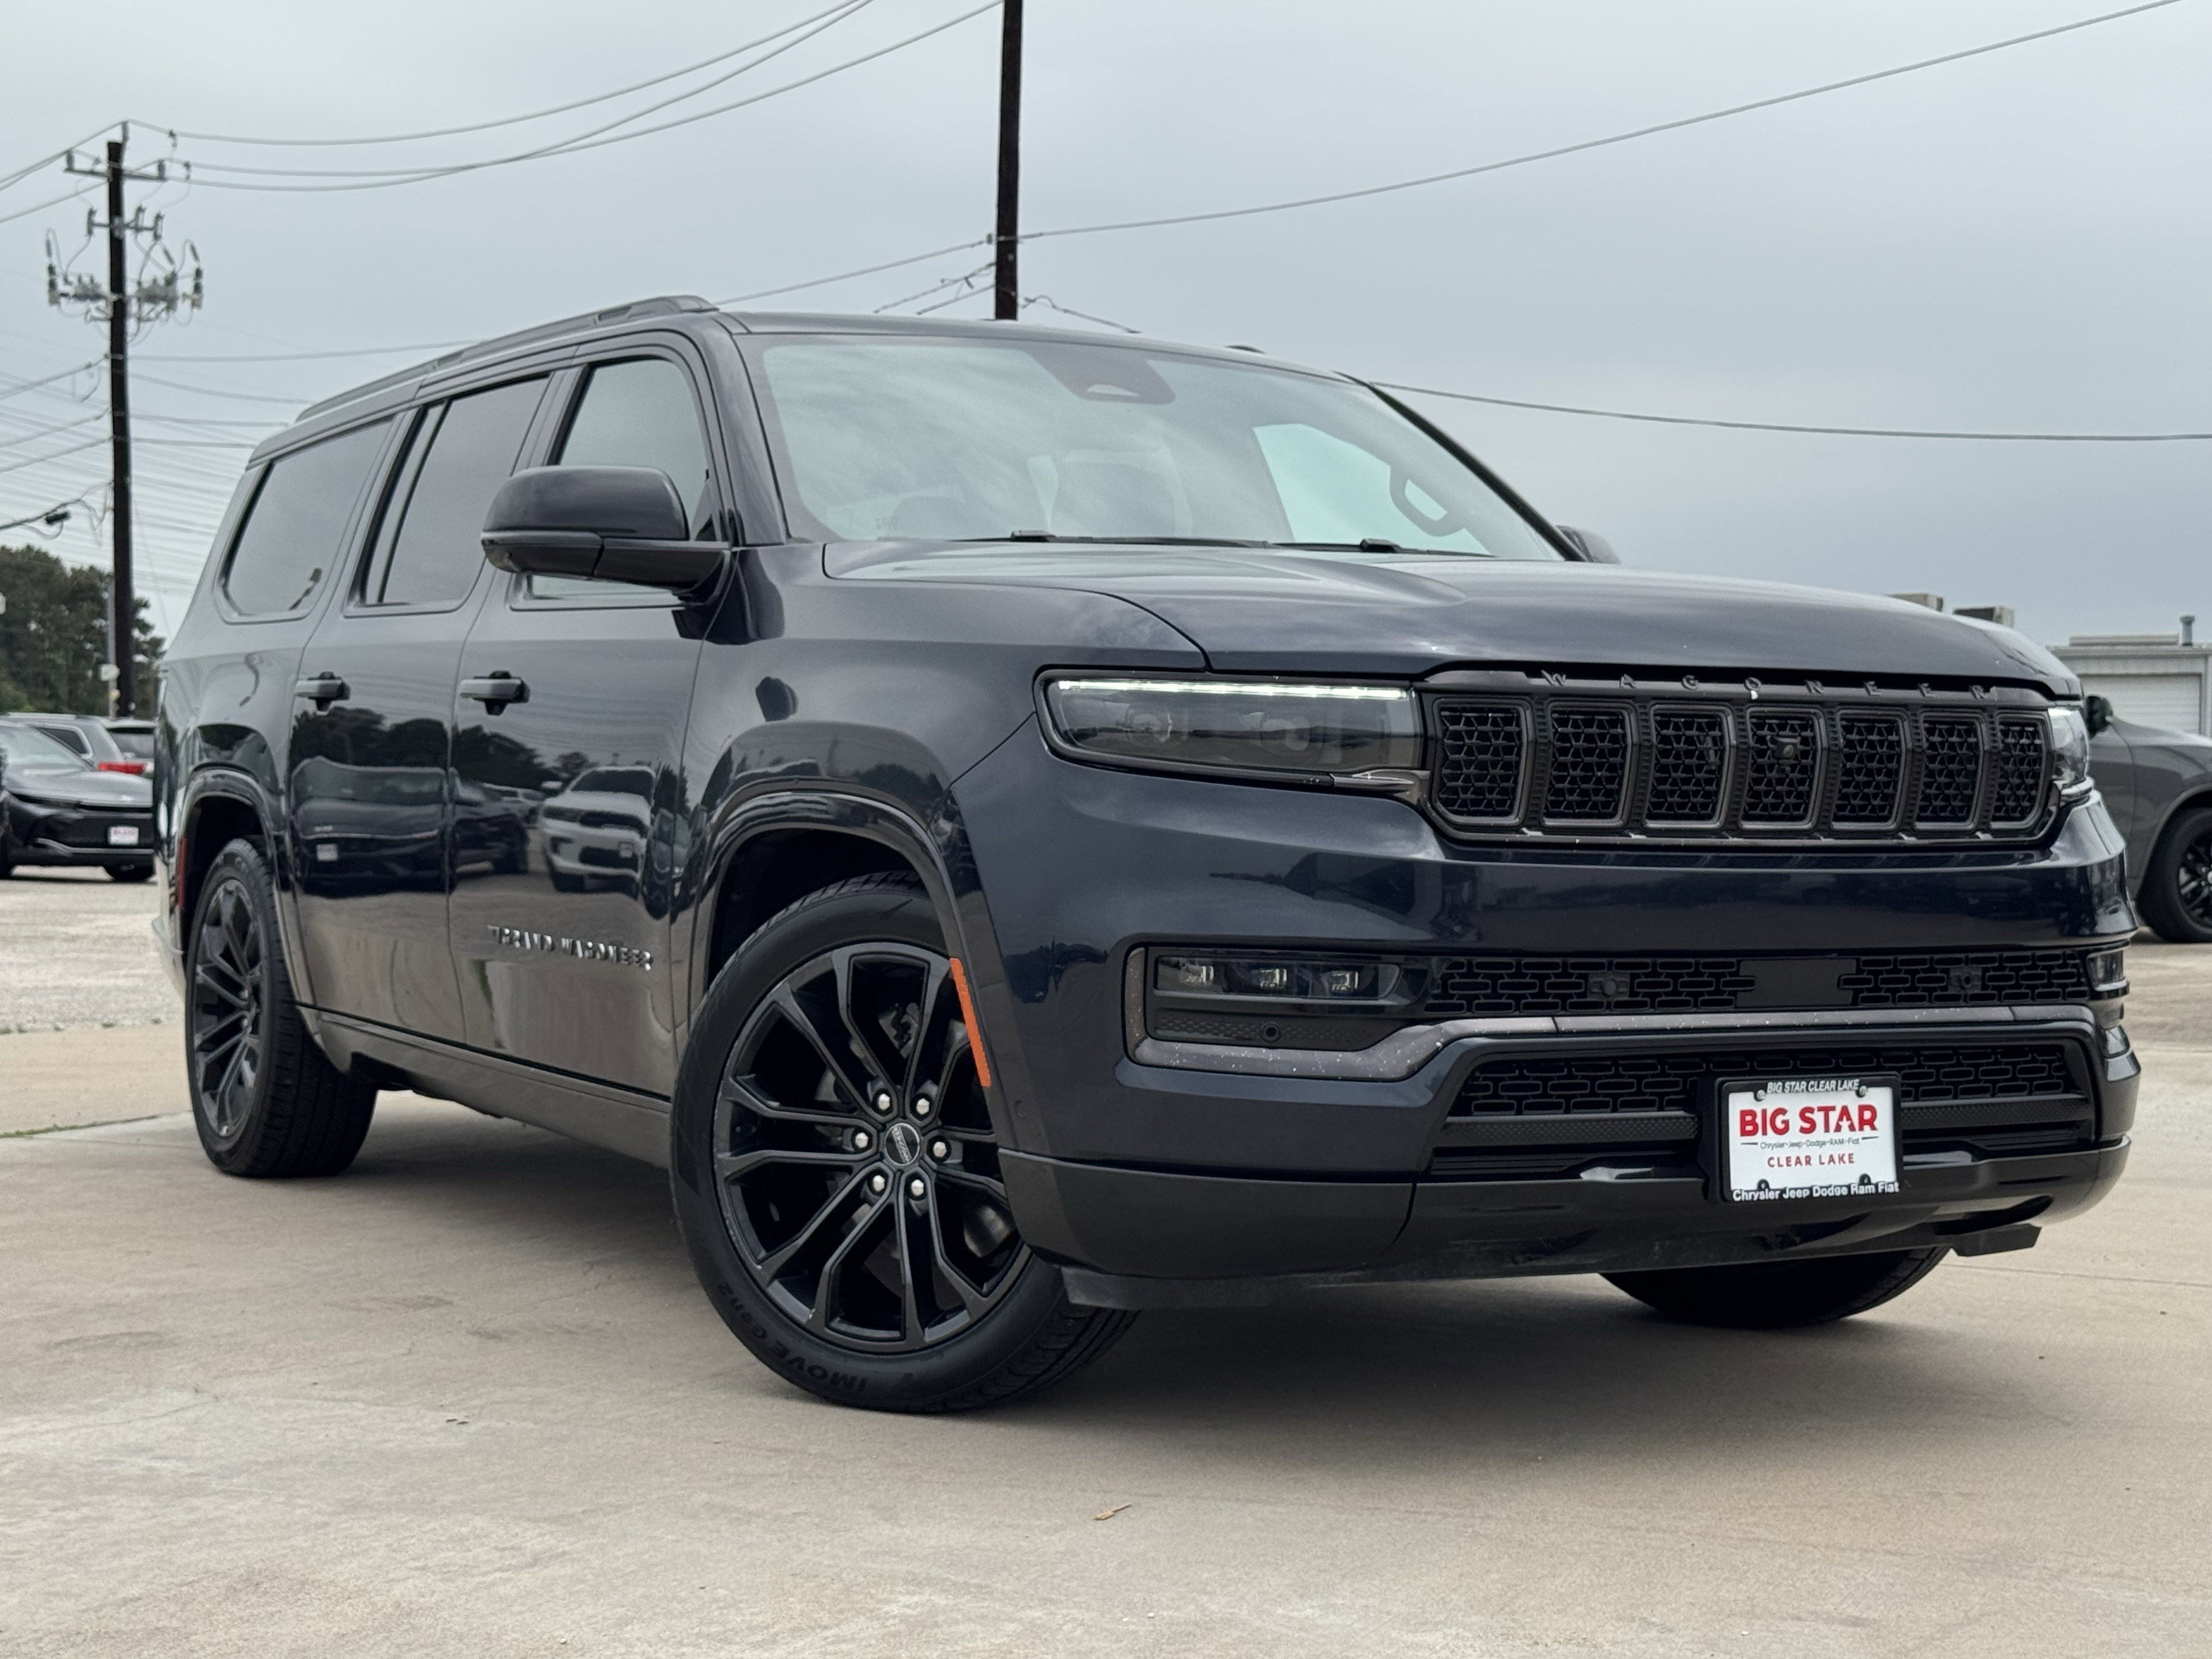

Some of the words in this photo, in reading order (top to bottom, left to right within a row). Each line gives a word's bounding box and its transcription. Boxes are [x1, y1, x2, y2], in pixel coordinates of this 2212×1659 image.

[1541, 669, 1988, 700] WAGONEER
[1767, 1082, 1782, 1093] BIG
[1784, 1081, 1807, 1093] STAR
[1808, 1080, 1837, 1092] CLEAR
[1838, 1079, 1860, 1091] LAKE
[1739, 1108, 1789, 1137] BIG
[1799, 1104, 1878, 1134] STAR
[1767, 1155, 1812, 1168] CLEAR
[1819, 1153, 1855, 1165] LAKE
[1733, 1187, 1781, 1202] Chrysler
[1783, 1186, 1810, 1200] Jeep
[1812, 1184, 1849, 1198] Dodge
[1850, 1183, 1876, 1195] Ram
[1878, 1180, 1900, 1194] Fiat
